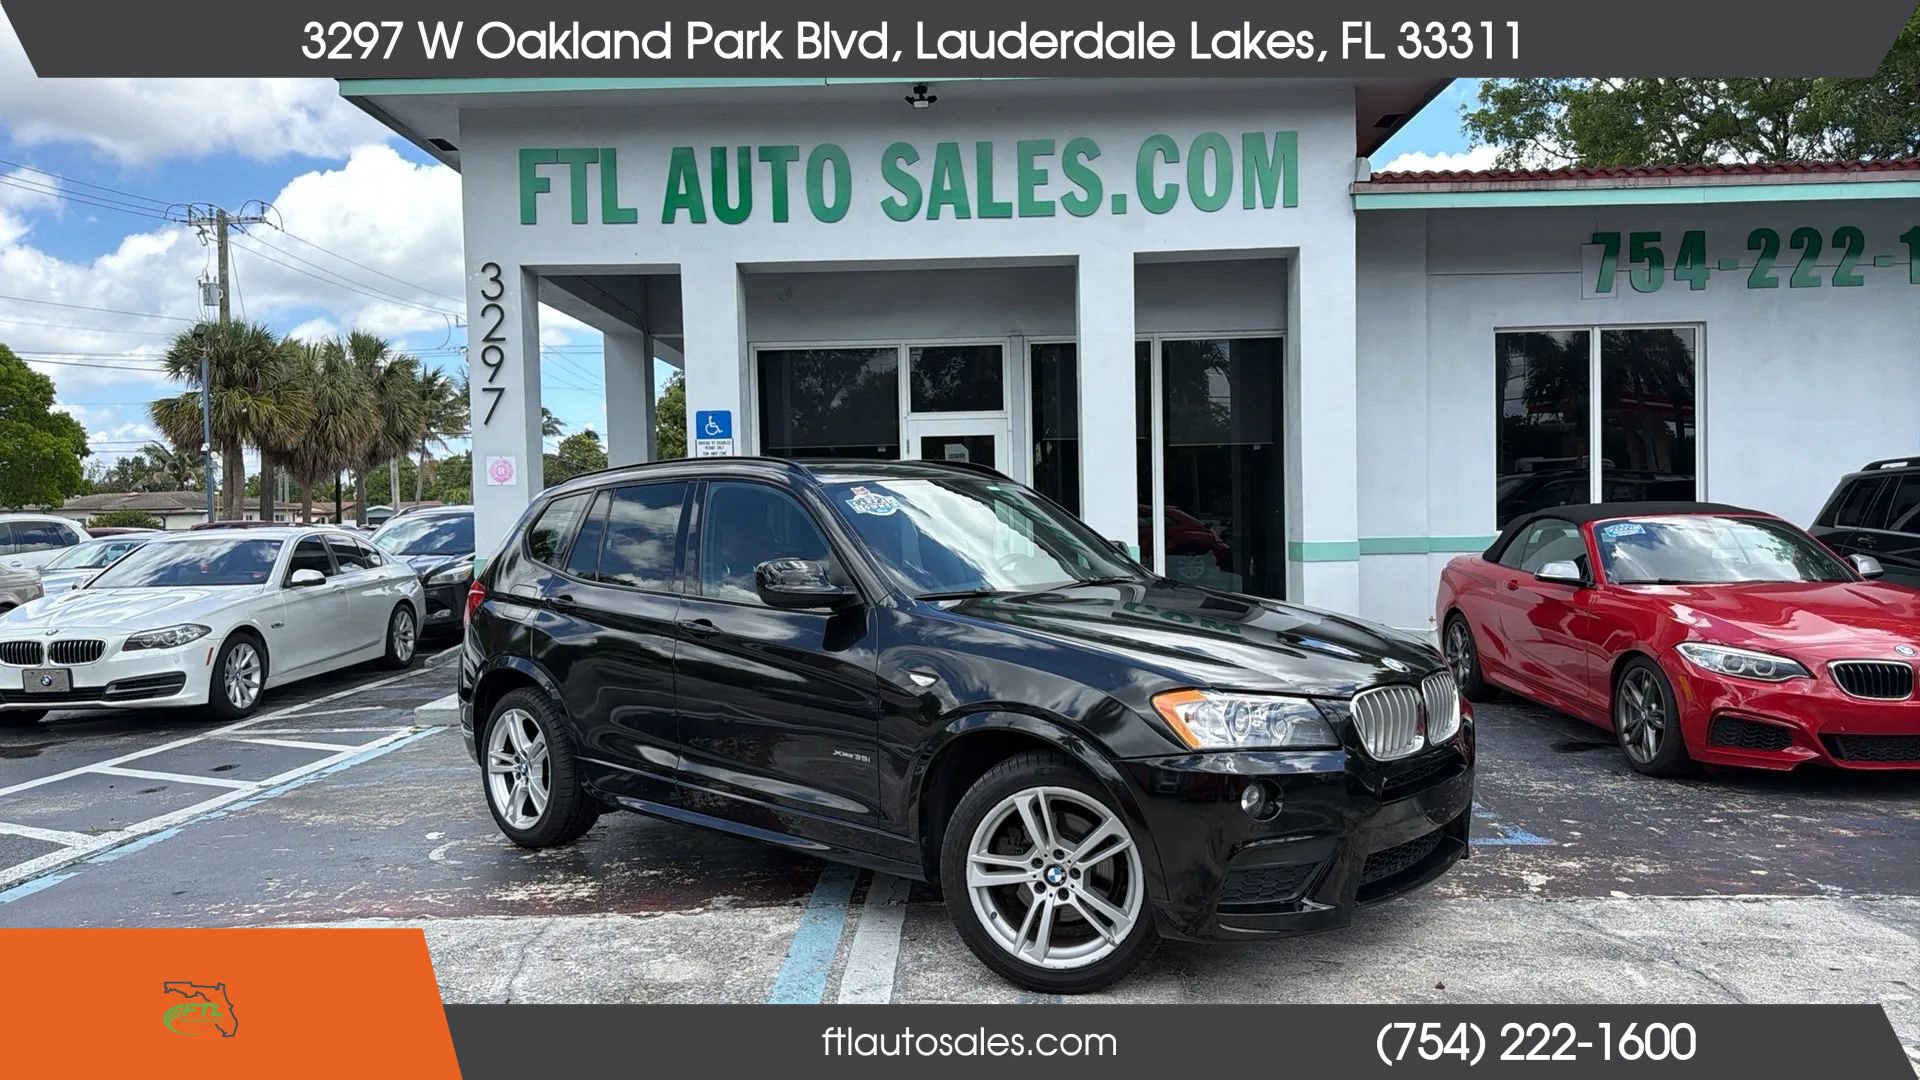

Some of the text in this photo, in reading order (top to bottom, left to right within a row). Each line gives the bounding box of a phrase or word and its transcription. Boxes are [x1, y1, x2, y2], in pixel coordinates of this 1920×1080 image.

[519, 130, 1298, 225] FTL AUTO SALES.COM
[480, 262, 506, 427] 3297
